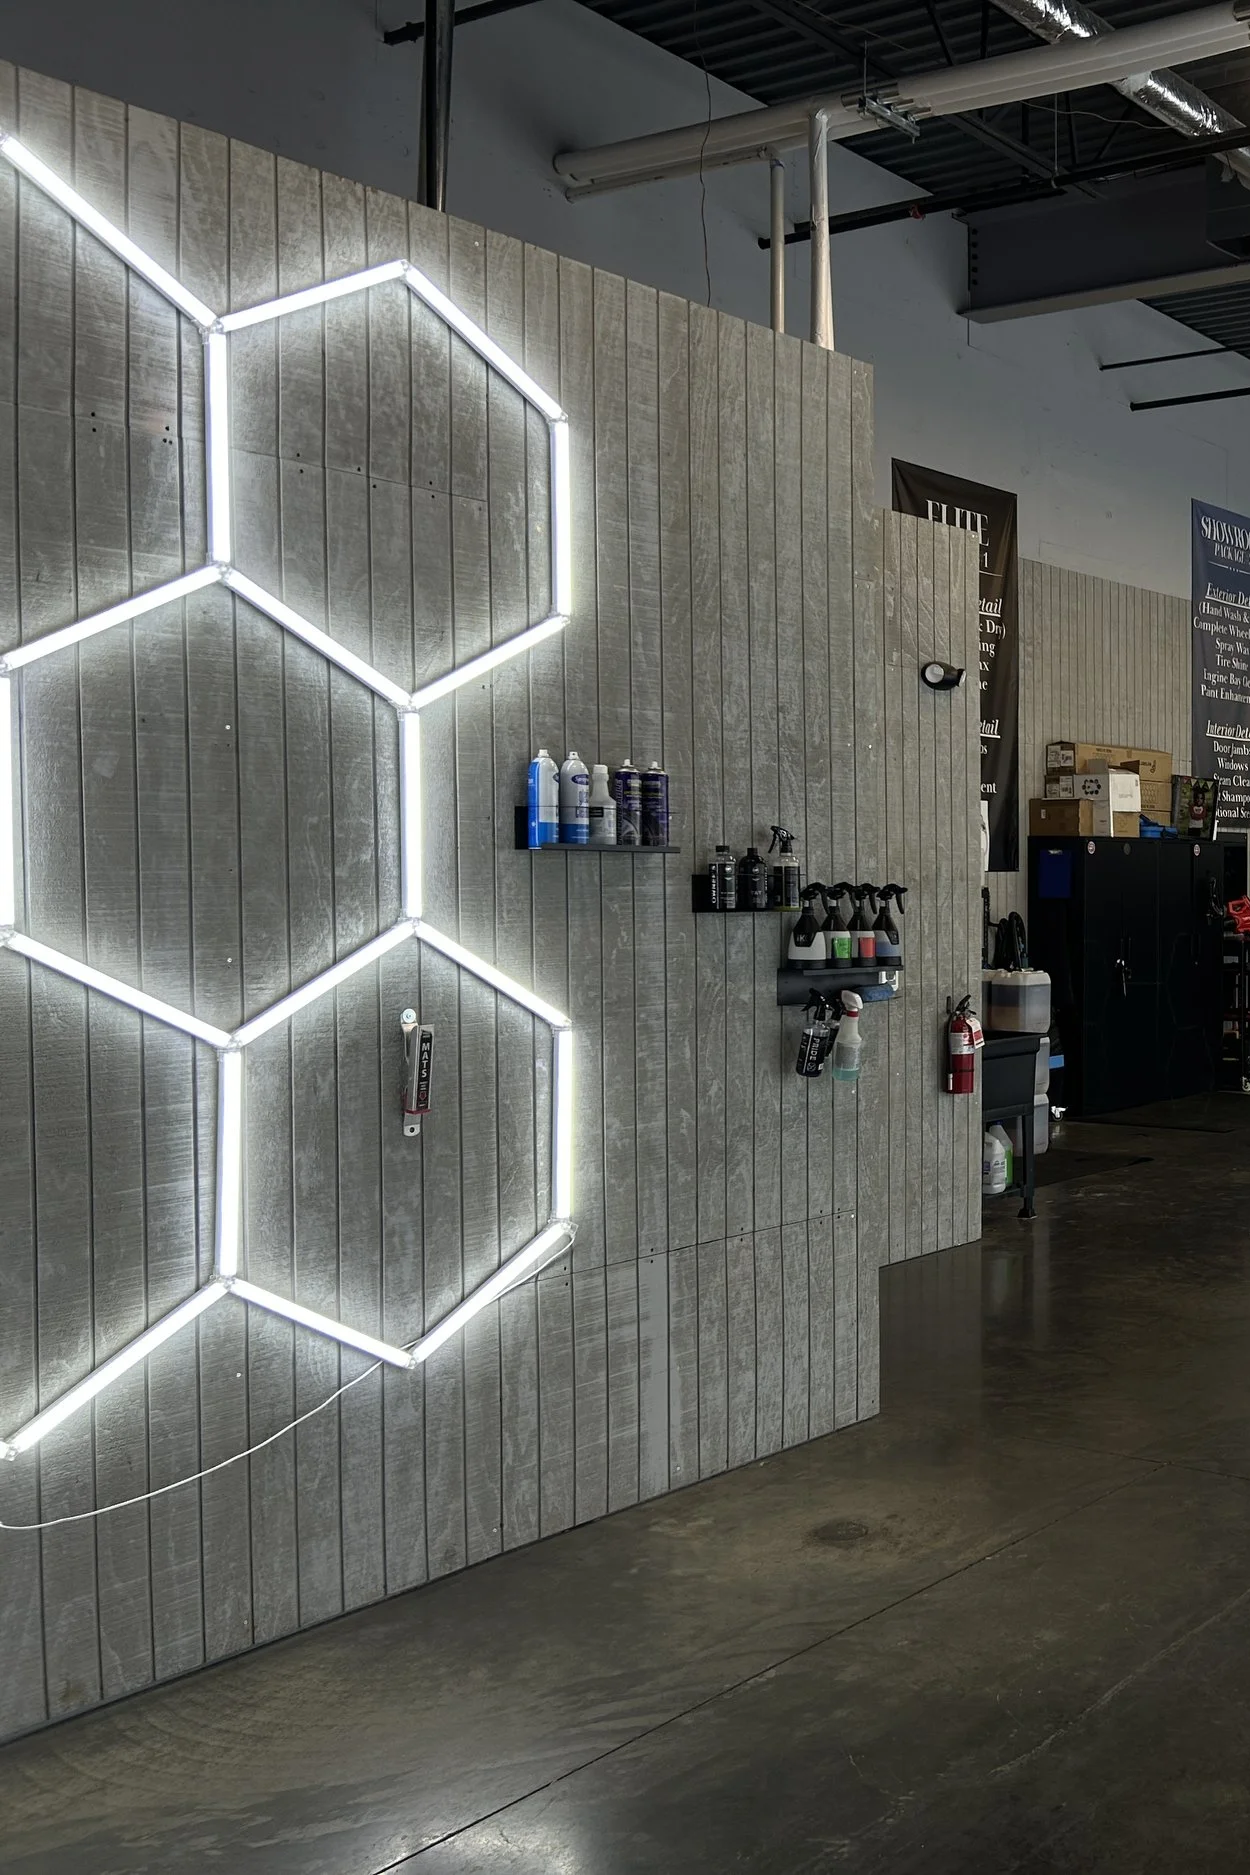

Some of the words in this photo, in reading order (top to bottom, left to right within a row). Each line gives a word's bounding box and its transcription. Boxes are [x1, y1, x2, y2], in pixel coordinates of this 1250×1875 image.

[1206, 581, 1237, 604] Exterior
[1199, 601, 1223, 618] (Hand
[1223, 606, 1242, 623] Wash
[1243, 611, 1250, 624] &
[1193, 616, 1228, 636] Complete
[1229, 623, 1250, 641] Wheel
[1215, 637, 1235, 656] Spray
[1235, 641, 1250, 656] Wax
[1216, 653, 1231, 668] Tire
[1203, 668, 1229, 686] Engine
[1229, 672, 1241, 690] Bay
[1200, 684, 1219, 699] Paint
[1207, 719, 1235, 738] Interior
[1213, 740, 1231, 754] Door
[1217, 756, 1249, 772] Windows
[809, 1037, 821, 1061] PRIDE
[421, 1042, 431, 1078] MATS
